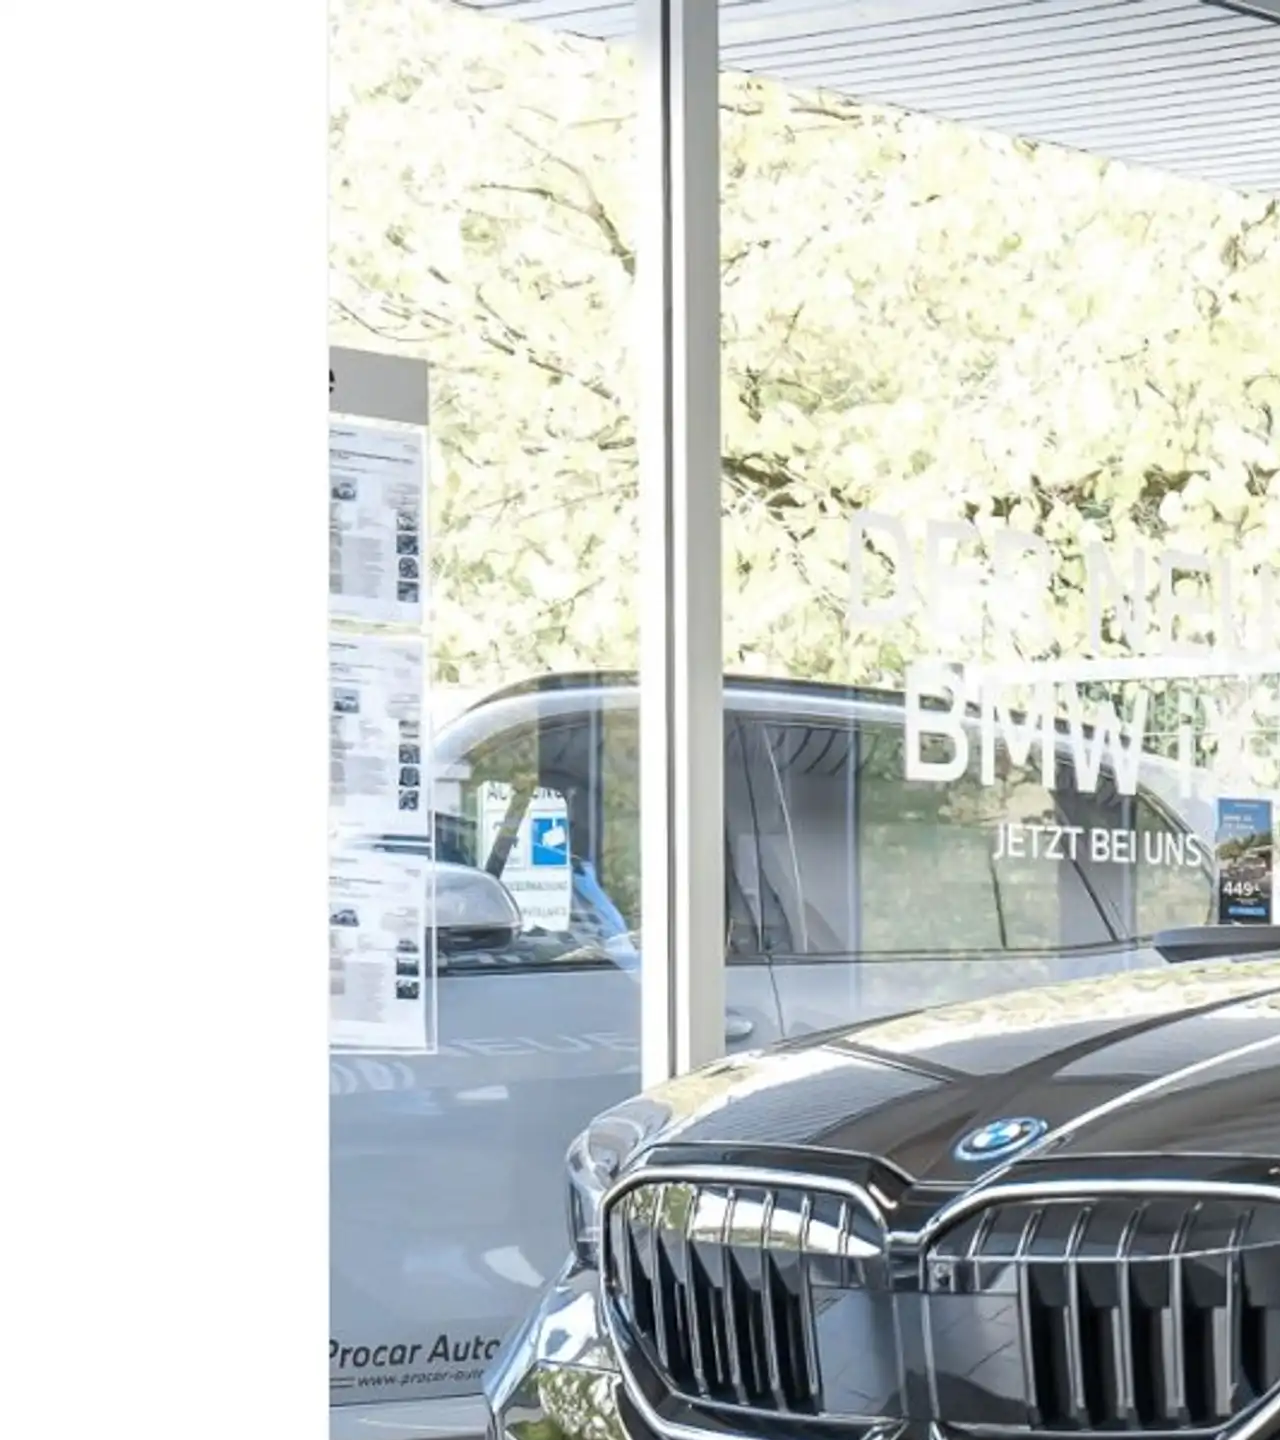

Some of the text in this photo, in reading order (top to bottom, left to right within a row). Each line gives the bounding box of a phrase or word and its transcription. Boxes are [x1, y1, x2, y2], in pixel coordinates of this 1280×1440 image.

[906, 662, 1147, 796] BMW
[993, 824, 1201, 867] JETZT BEI UNS
